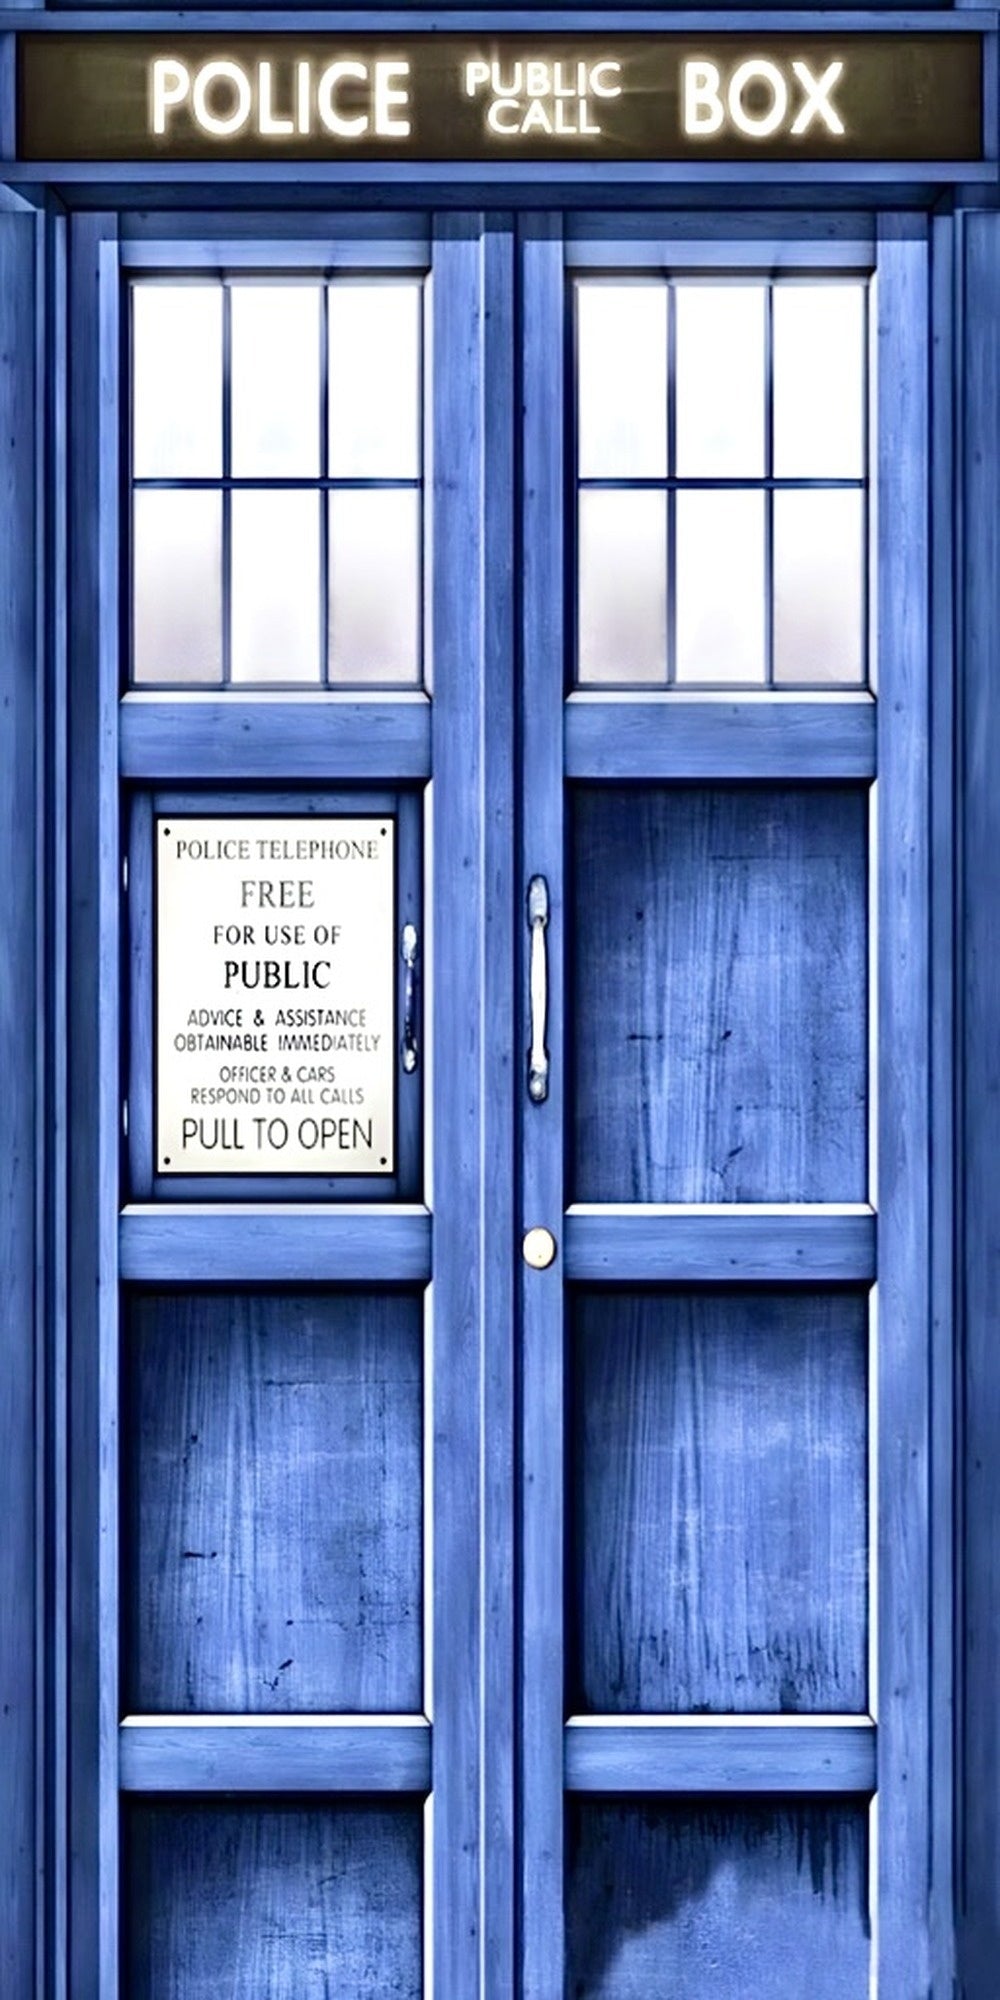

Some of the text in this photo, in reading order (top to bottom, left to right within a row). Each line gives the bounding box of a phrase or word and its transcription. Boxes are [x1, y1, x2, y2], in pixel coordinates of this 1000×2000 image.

[467, 62, 621, 97] PUBLIC
[154, 60, 409, 136] POLICE
[685, 60, 844, 136] BOX
[488, 98, 600, 133] CALL
[177, 840, 378, 859] POLICE TELEPHONE
[241, 881, 314, 908] FREE
[214, 925, 340, 945] FOR USE OF
[224, 961, 331, 989] PUBLIC
[188, 1009, 365, 1027] ADVICE & ASSISTANCE
[174, 1033, 380, 1052] OBTAINABLE IMMEDIATELY
[220, 1066, 334, 1083] OFFICER & CARS
[191, 1088, 363, 1104] RESPOND TO ALL CALLS
[183, 1118, 372, 1150] PULL TO OPEN
